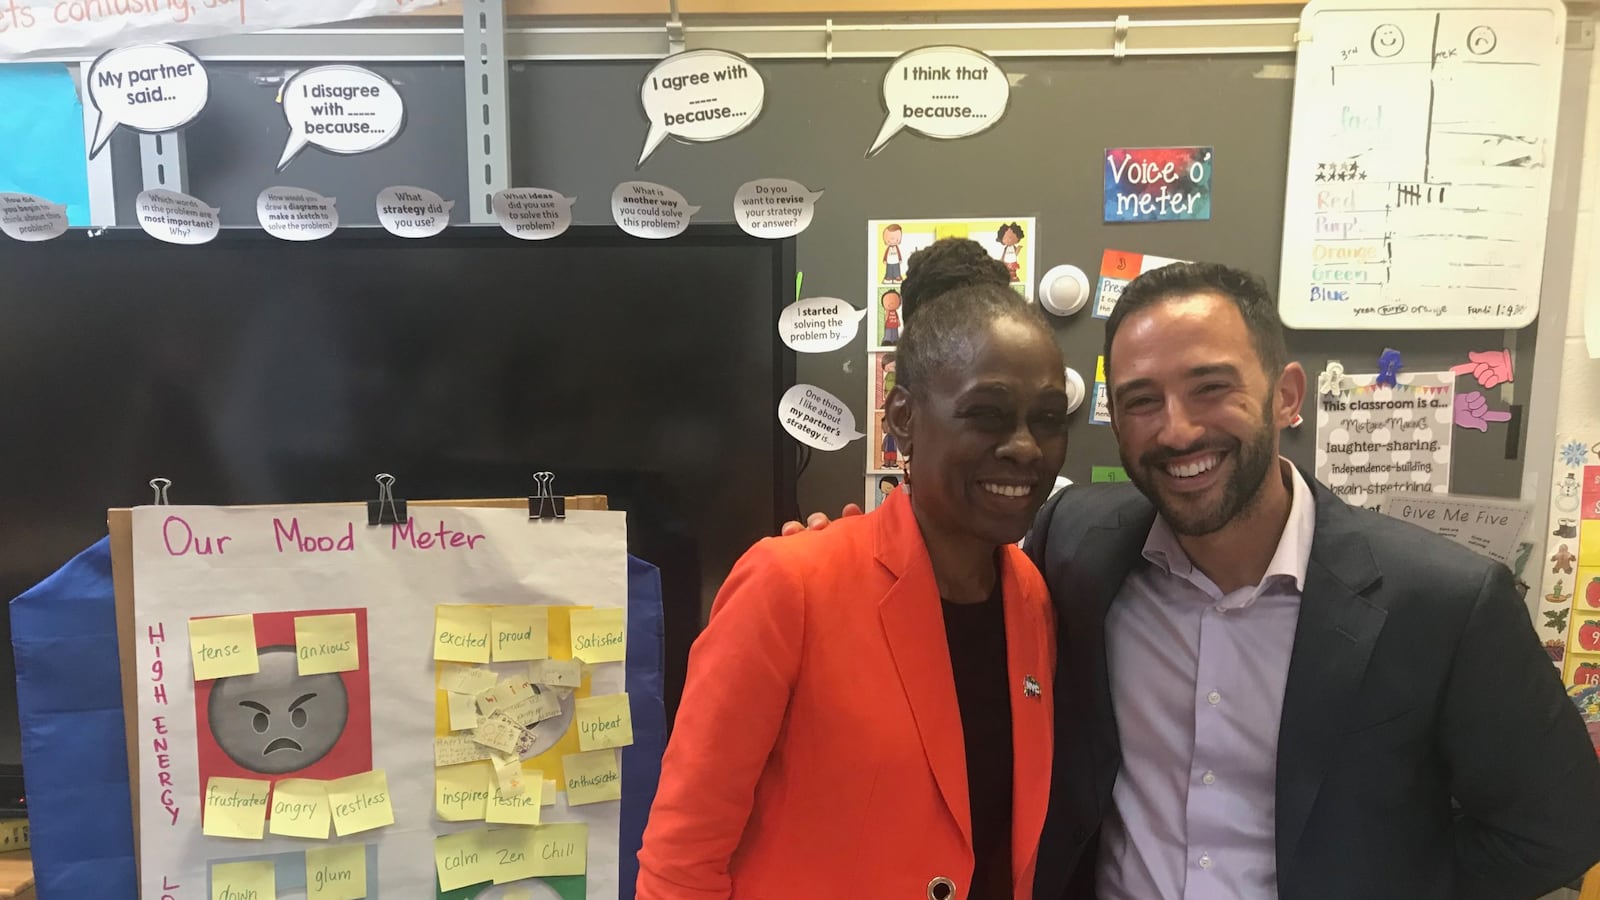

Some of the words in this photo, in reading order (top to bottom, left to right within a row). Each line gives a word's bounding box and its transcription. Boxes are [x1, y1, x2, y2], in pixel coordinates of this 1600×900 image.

[98, 70, 123, 88] My
[128, 63, 195, 87] partner
[653, 77, 659, 91] I
[661, 72, 710, 91] agree
[713, 65, 748, 82] with
[903, 67, 908, 80] I
[912, 66, 951, 80] think
[956, 66, 989, 80] that
[126, 85, 177, 105] said...
[303, 84, 308, 98] I
[311, 84, 380, 100] disagree
[311, 102, 344, 116] with
[1107, 153, 1179, 184] Voice
[394, 192, 423, 202] What
[632, 185, 656, 196] What
[657, 188, 665, 197] is
[756, 185, 769, 194] Do
[770, 186, 788, 195] you
[288, 202, 319, 212] diagram
[508, 201, 522, 209] did
[522, 202, 539, 210] you
[623, 196, 659, 206] another
[660, 200, 678, 208] way
[742, 197, 764, 206] want
[765, 197, 775, 205] to
[776, 194, 804, 204] revise
[1116, 186, 1201, 216] meter
[142, 204, 150, 212] in
[151, 203, 164, 213] the
[166, 207, 198, 217] problem
[199, 211, 213, 219] are
[296, 212, 320, 220] sketch
[383, 204, 426, 216] strategy
[427, 203, 443, 214] did
[509, 212, 519, 220] to
[520, 210, 542, 219] solve
[542, 210, 560, 219] this
[620, 207, 636, 216] you
[637, 207, 660, 217] could
[661, 209, 683, 218] solve
[745, 208, 765, 219] your
[767, 207, 803, 217] strategy
[19, 221, 54, 235] problem?
[144, 215, 166, 223] most
[167, 215, 214, 229] important?
[268, 222, 287, 230] solve
[287, 221, 300, 230] the
[301, 221, 333, 231] problem?
[394, 219, 413, 230] you
[414, 216, 435, 228] use?
[516, 221, 556, 233] problem?
[623, 217, 640, 227] this
[641, 218, 681, 230] problem?
[762, 217, 798, 228] answer?
[169, 227, 191, 238] Why?
[1310, 286, 1350, 302] Blue
[797, 307, 801, 316] I
[802, 305, 838, 316] started
[794, 319, 826, 331] solving
[827, 318, 843, 327] the
[790, 330, 828, 343] problem
[805, 389, 821, 403] One
[822, 399, 843, 415] thing
[1322, 400, 1346, 412] This
[1349, 399, 1415, 411] classroom
[1417, 398, 1427, 408] is
[1429, 399, 1448, 408] a...
[803, 399, 818, 413] like
[818, 408, 841, 425] about
[786, 417, 821, 440] strategy
[790, 406, 803, 419] my
[804, 413, 841, 437] partner's
[1402, 505, 1436, 520] Give
[1443, 508, 1470, 522] Me
[1475, 510, 1509, 526] Five
[162, 515, 232, 557] Our
[272, 517, 355, 553] Mood
[391, 515, 486, 551] Meter
[439, 630, 488, 649] excited
[498, 626, 532, 650] proud
[197, 642, 241, 662] tense
[299, 639, 351, 660] anxious
[581, 716, 622, 741] upbeat
[207, 785, 270, 808] frustrated
[274, 801, 318, 822] angry
[335, 791, 386, 818] restless
[444, 849, 479, 871] calm
[495, 848, 526, 865] Zen
[315, 870, 352, 892] glum
[219, 884, 258, 900] down
